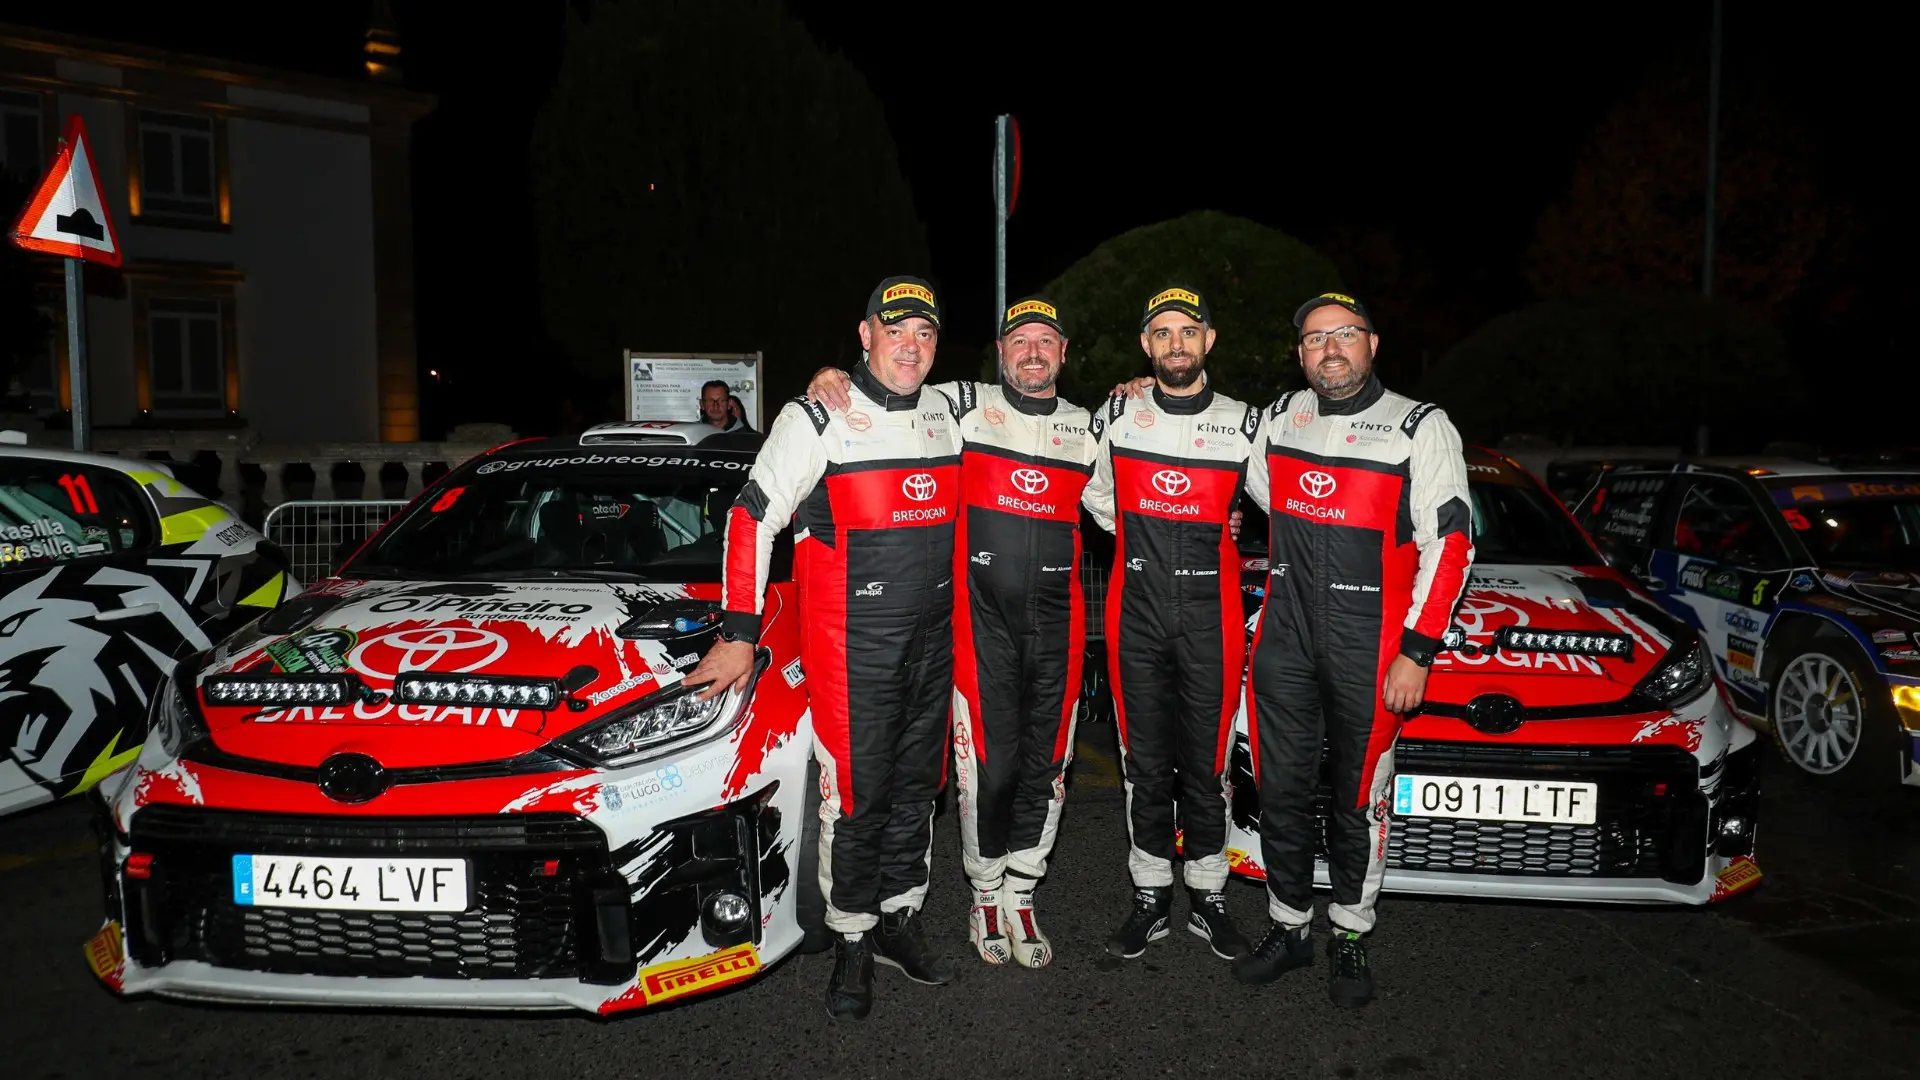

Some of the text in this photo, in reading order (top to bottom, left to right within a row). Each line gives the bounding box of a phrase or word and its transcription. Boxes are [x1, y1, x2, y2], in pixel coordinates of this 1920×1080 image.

[886, 285, 933, 303] PIRELLI
[57, 474, 100, 515] 11
[893, 506, 946, 522] BREOGAN
[997, 494, 1056, 515] BREOGAN
[1139, 498, 1199, 515] BREOGAN
[1286, 498, 1346, 520] BREOGAN
[1782, 508, 1811, 531] 5
[856, 587, 882, 597] galuppo
[1330, 582, 1359, 591] Adrián
[423, 597, 593, 615] Piñeiro
[671, 652, 699, 668] 2027
[588, 672, 653, 706] Xacobeo
[631, 783, 661, 800] LUGO
[1422, 782, 1588, 818] 0911 LTF
[241, 883, 249, 894] E
[263, 863, 454, 903] 4464 LVF
[1032, 947, 1044, 968] OMP
[645, 950, 755, 996] PIRELLI
